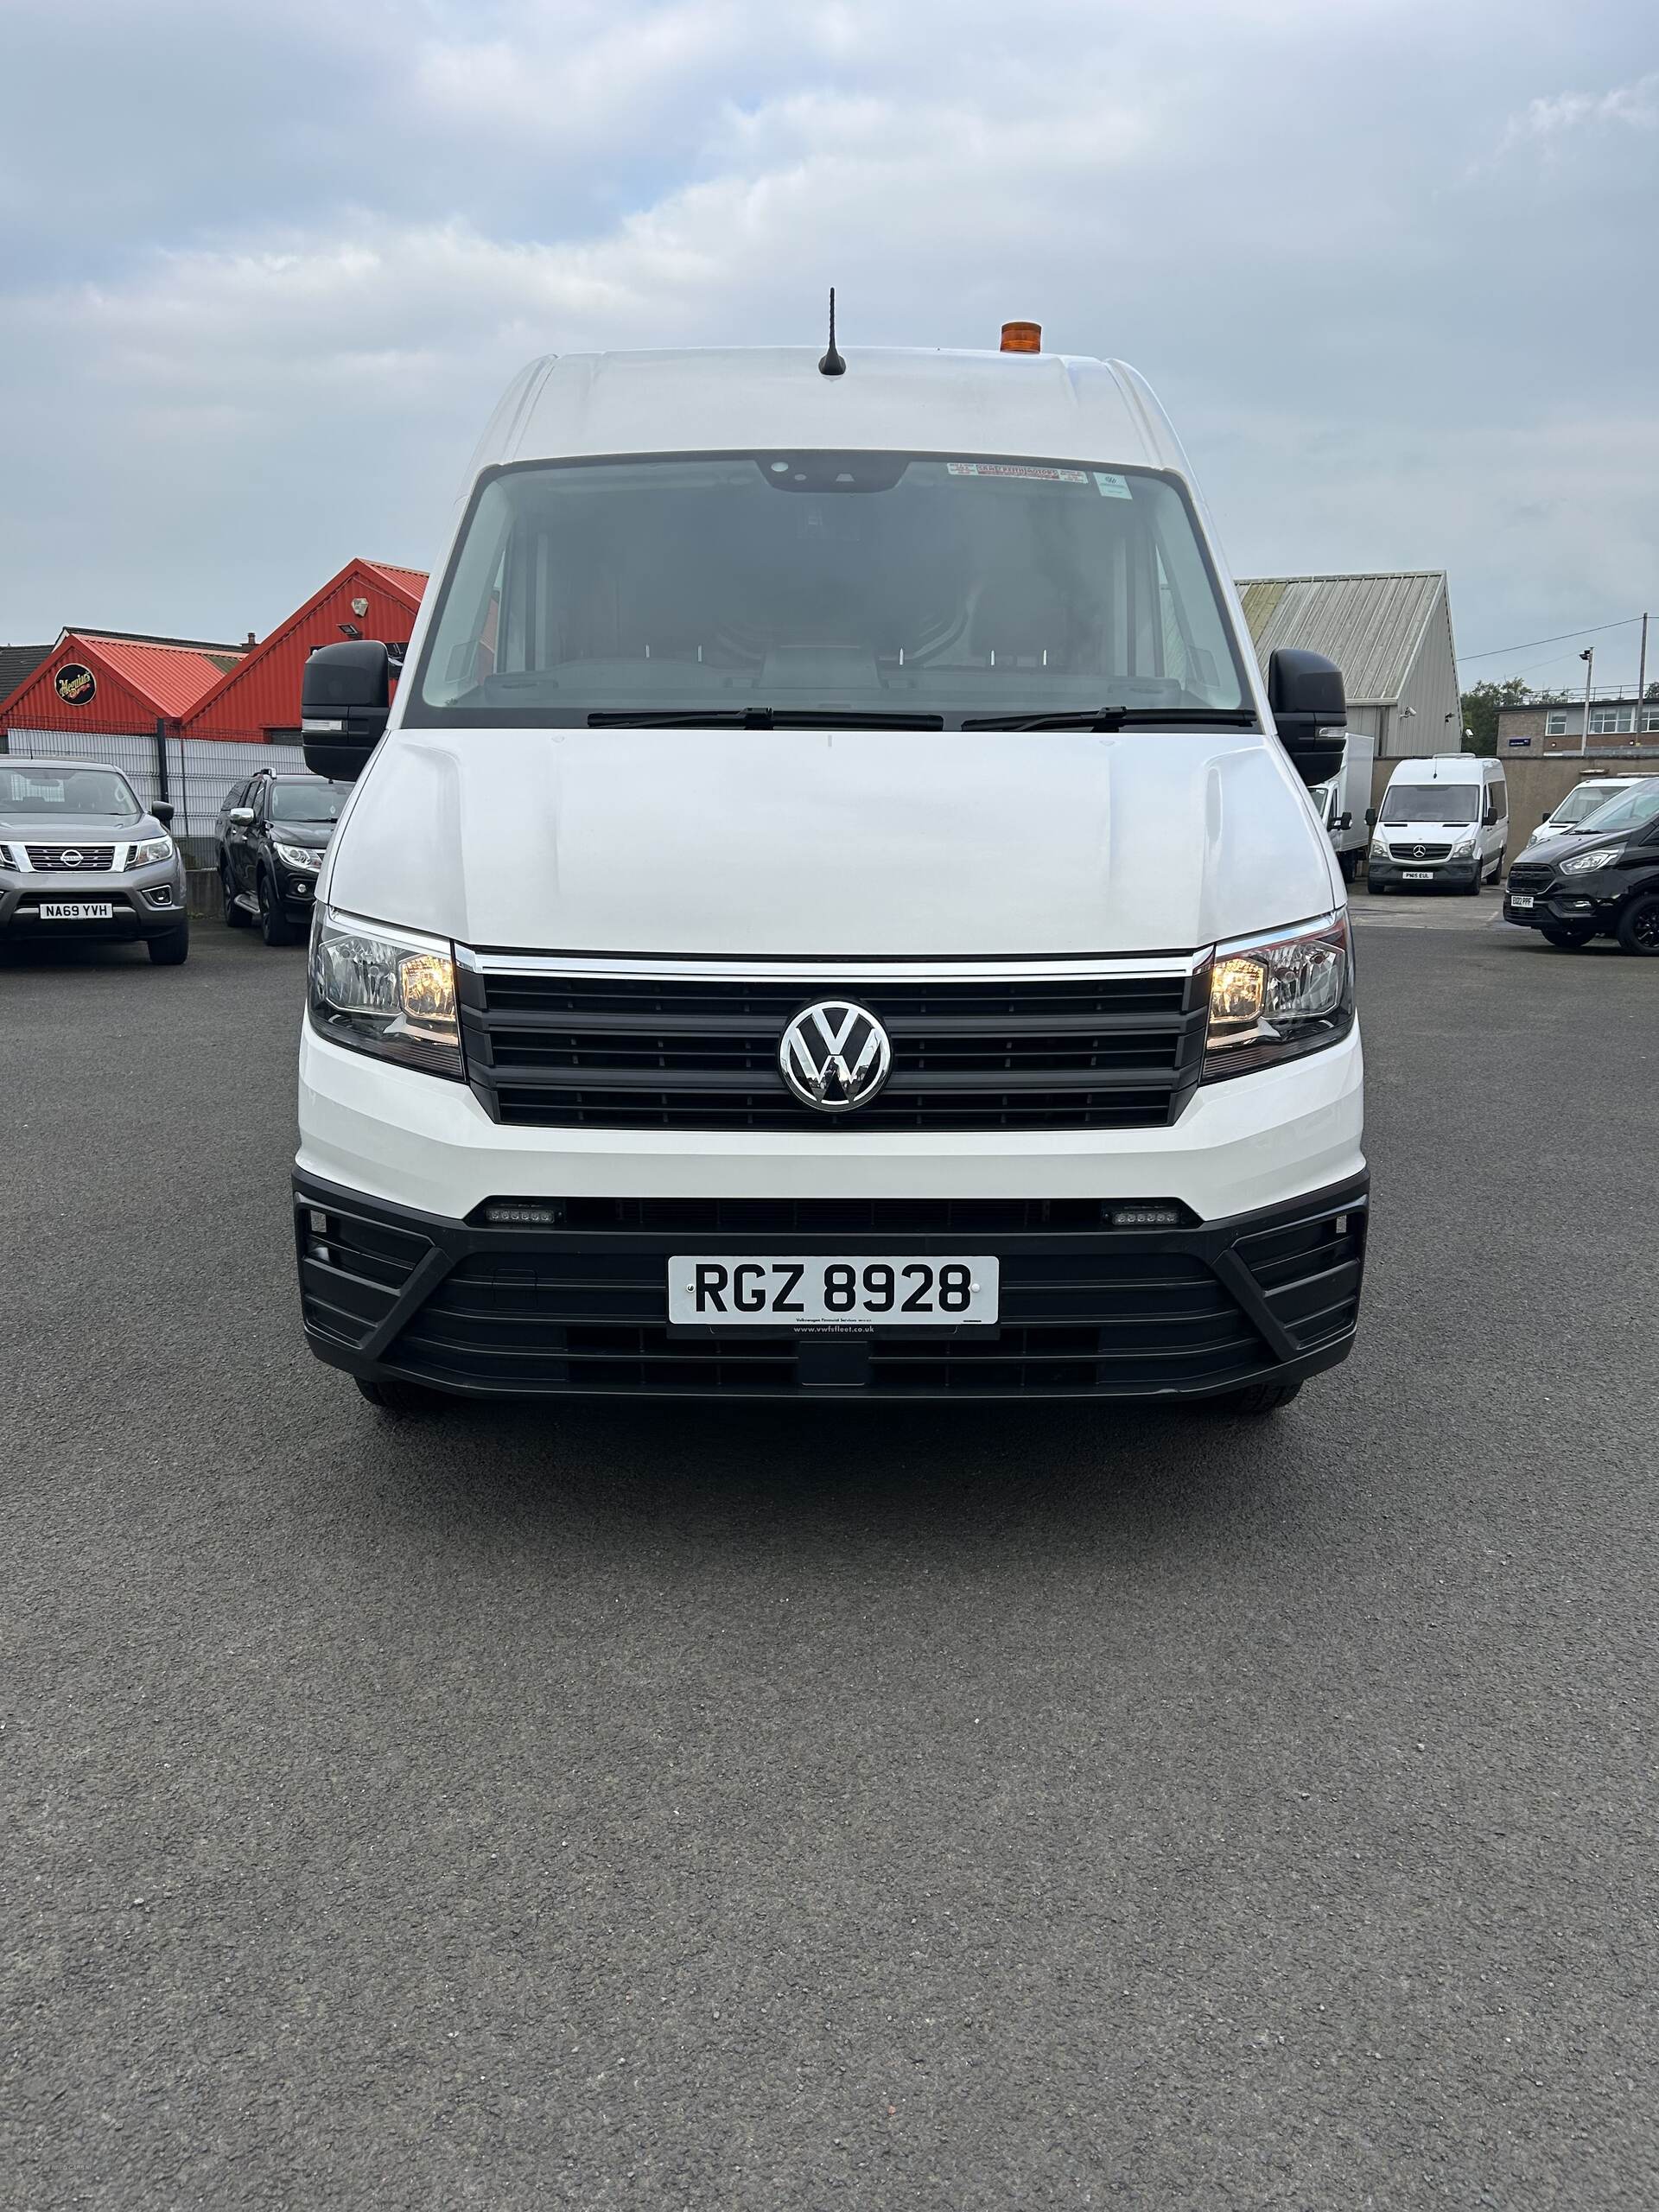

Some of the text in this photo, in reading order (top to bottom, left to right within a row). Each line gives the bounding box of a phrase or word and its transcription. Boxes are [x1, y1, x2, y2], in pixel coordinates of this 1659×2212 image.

[47, 905, 107, 917] NA69 YVH
[695, 1263, 971, 1313] RGZ 8928
